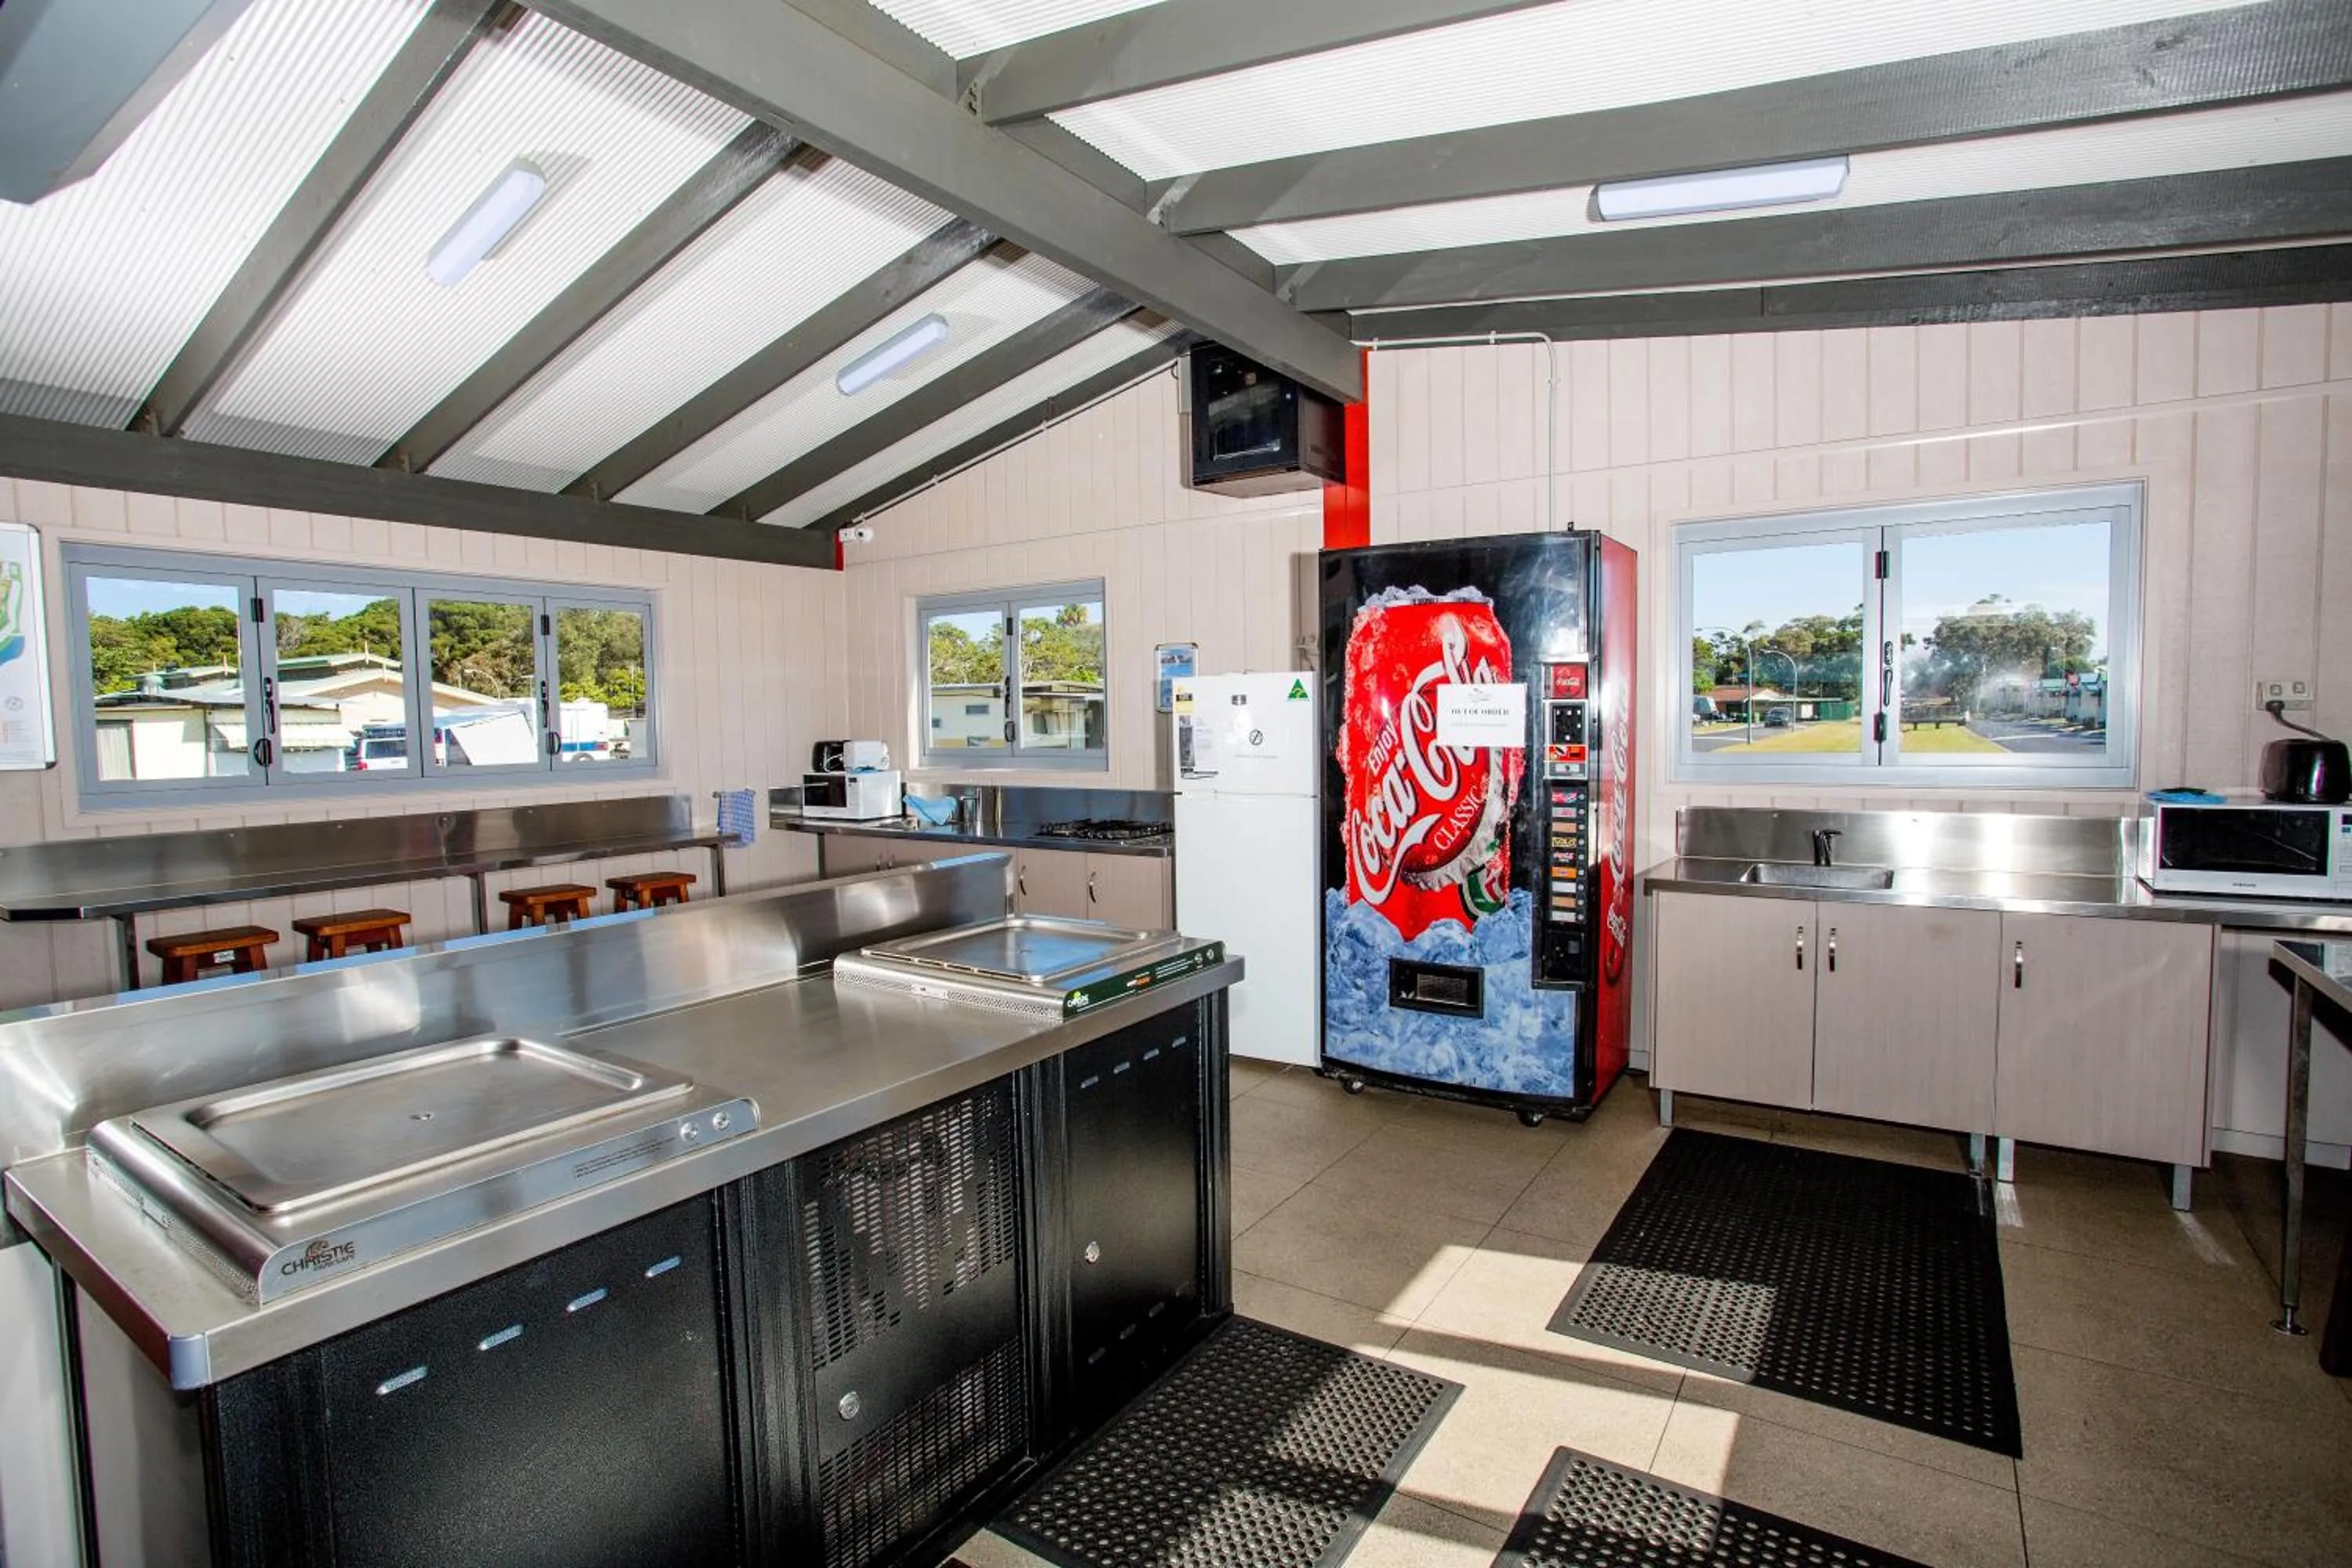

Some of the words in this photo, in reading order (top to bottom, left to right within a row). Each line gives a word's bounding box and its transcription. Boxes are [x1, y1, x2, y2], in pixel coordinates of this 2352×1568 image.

[1368, 717, 1399, 776] Enjoy
[1434, 785, 1483, 851] CLASSIC
[281, 1241, 355, 1275] CHRISTIE
